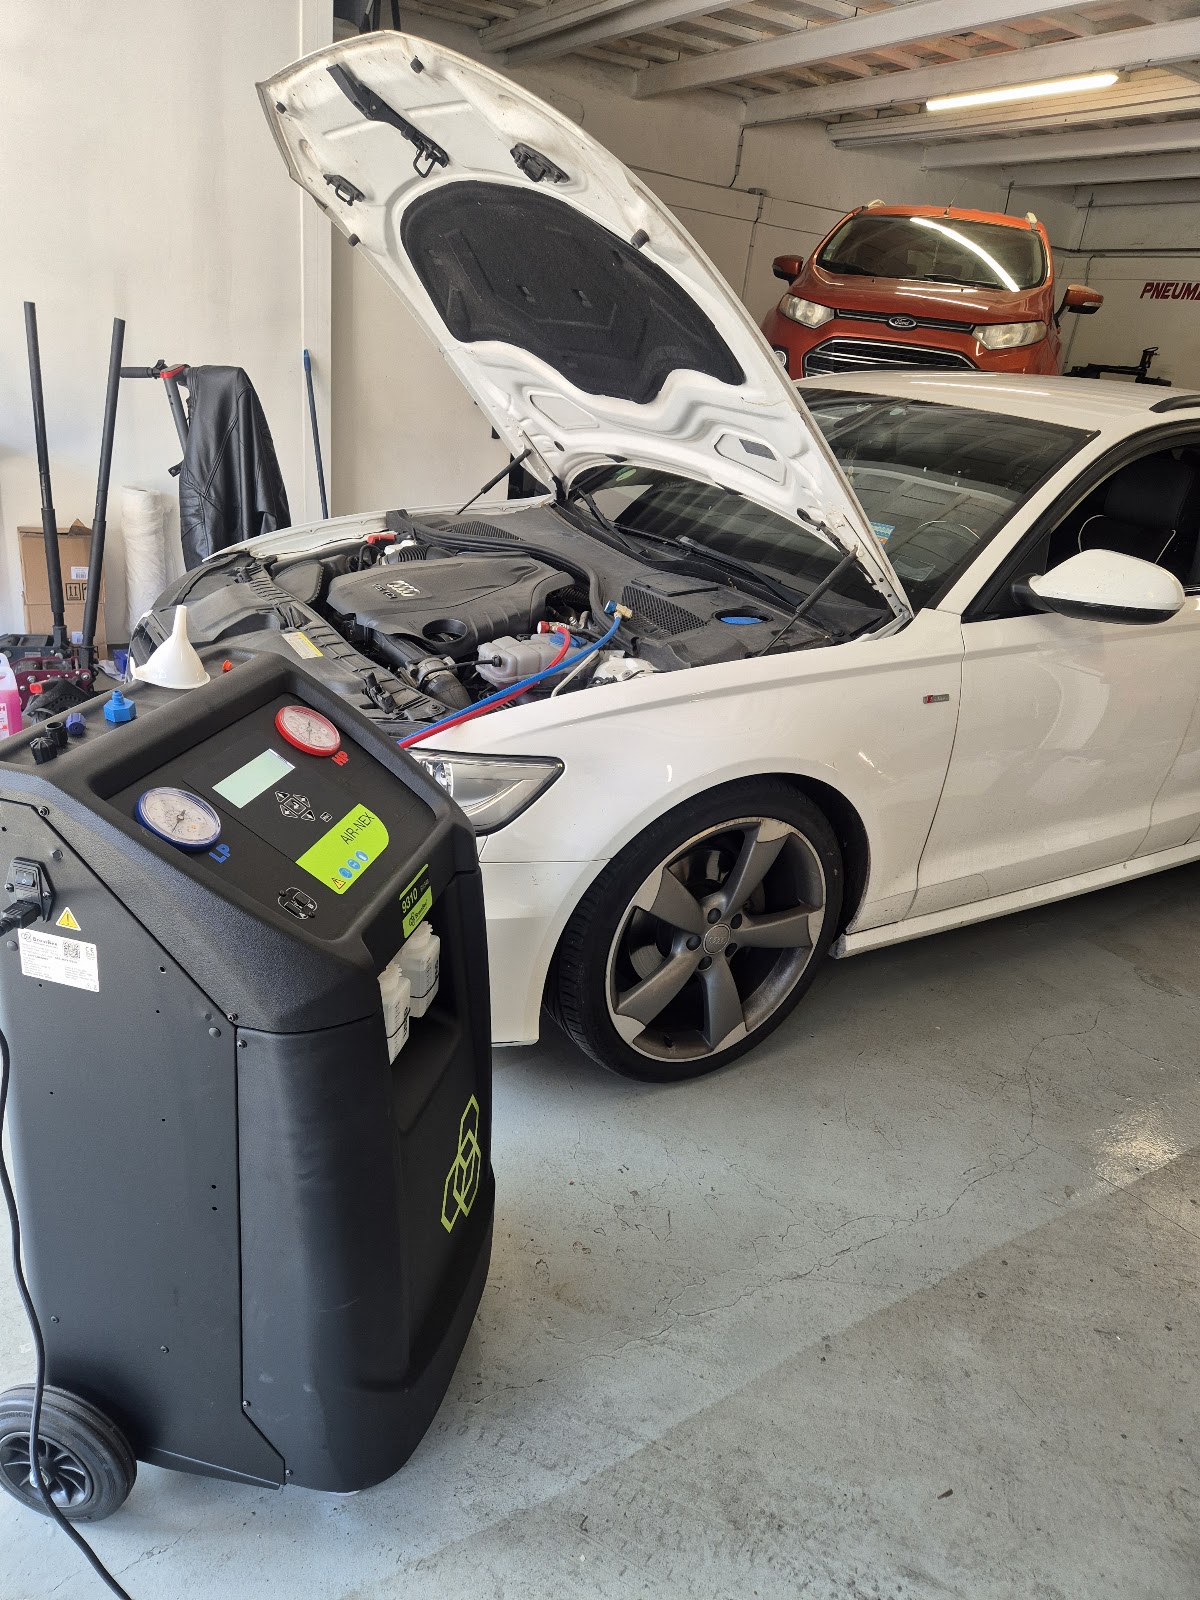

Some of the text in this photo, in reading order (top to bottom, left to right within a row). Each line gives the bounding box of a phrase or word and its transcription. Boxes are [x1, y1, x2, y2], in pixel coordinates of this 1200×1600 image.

[331, 751, 349, 767] HP
[340, 812, 375, 845] AIR-NEX
[208, 843, 231, 864] LP
[402, 887, 418, 914] 9310
